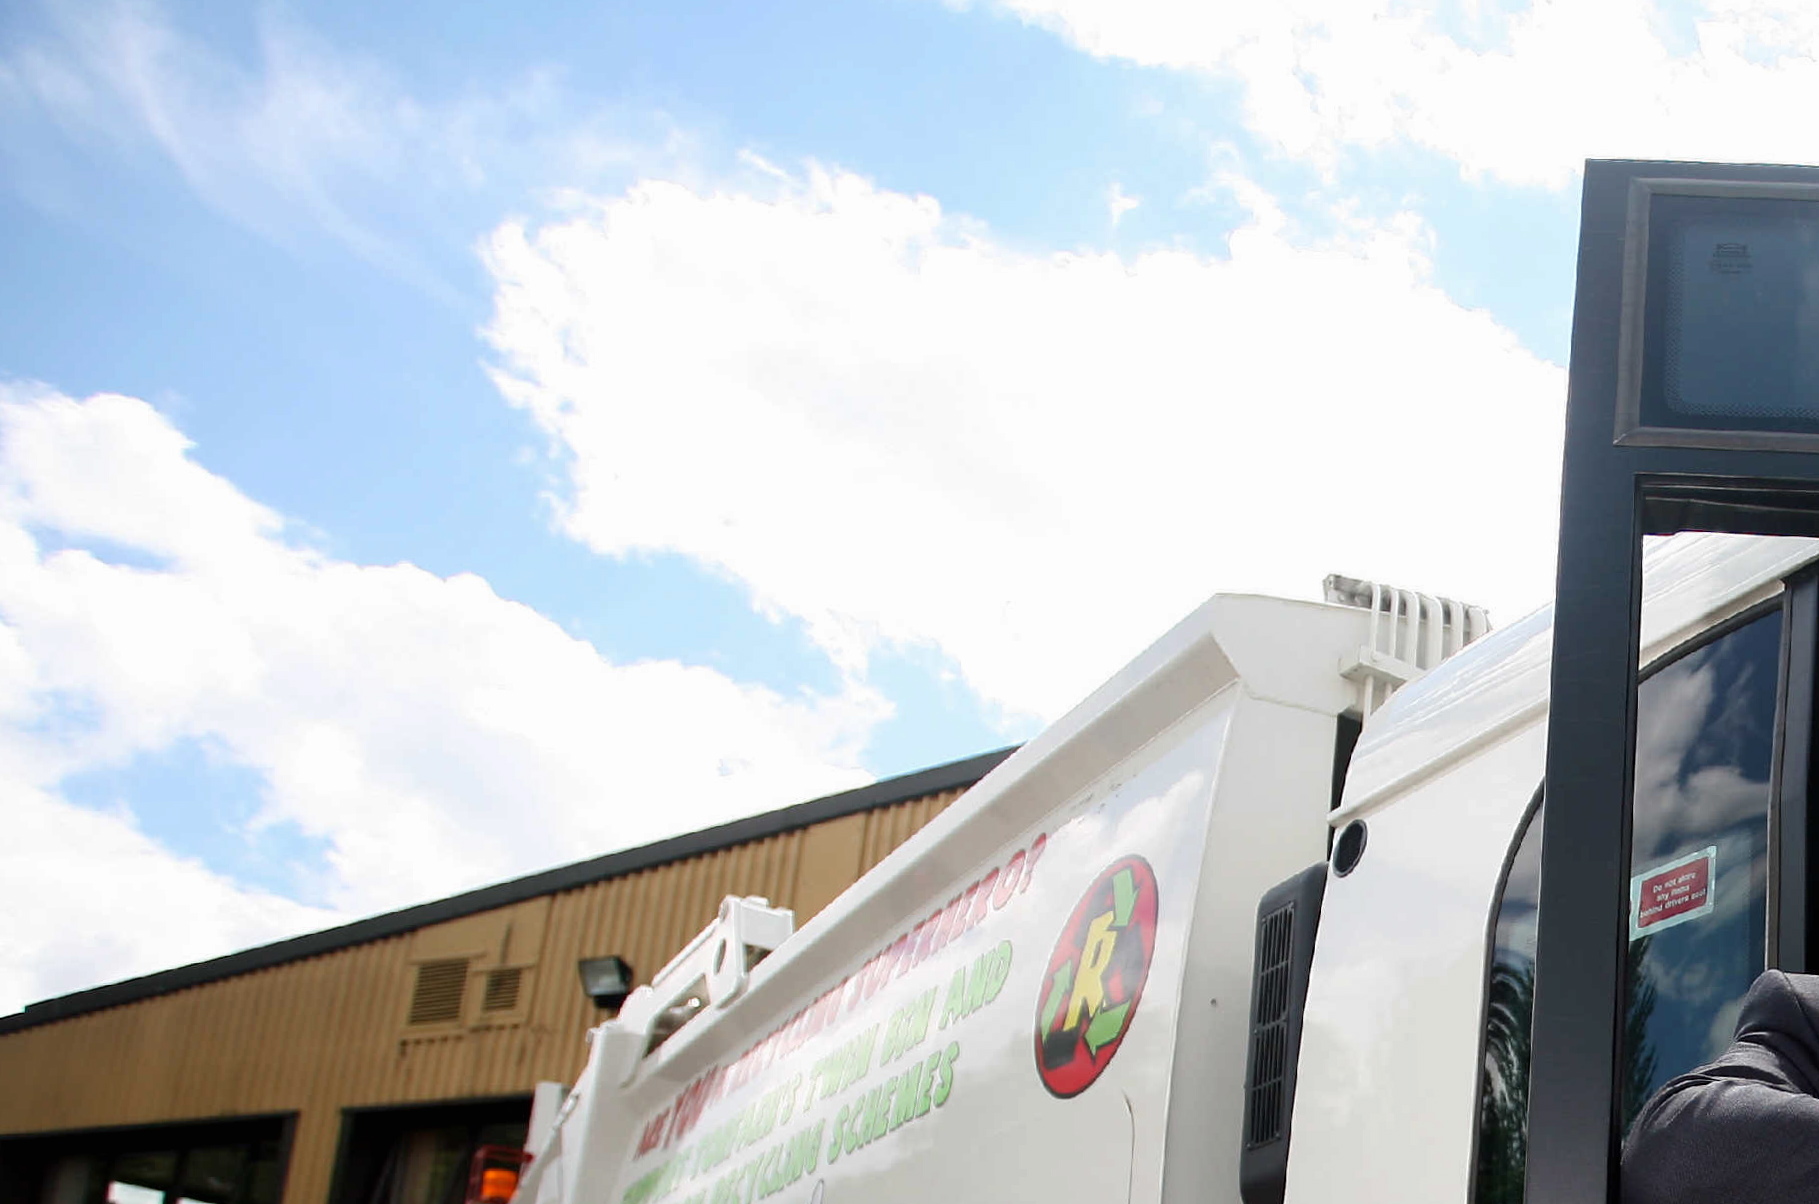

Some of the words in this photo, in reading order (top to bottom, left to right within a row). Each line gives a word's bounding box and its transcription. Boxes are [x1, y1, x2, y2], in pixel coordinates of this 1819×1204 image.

[1640, 903, 1663, 918] behind
[1664, 895, 1689, 909] drivers
[1653, 884, 1662, 894] Do
[803, 1022, 880, 1114] TWIN
[879, 985, 938, 1068] BIN
[937, 938, 1013, 1030] AND
[827, 1040, 960, 1166] SCHEMES
